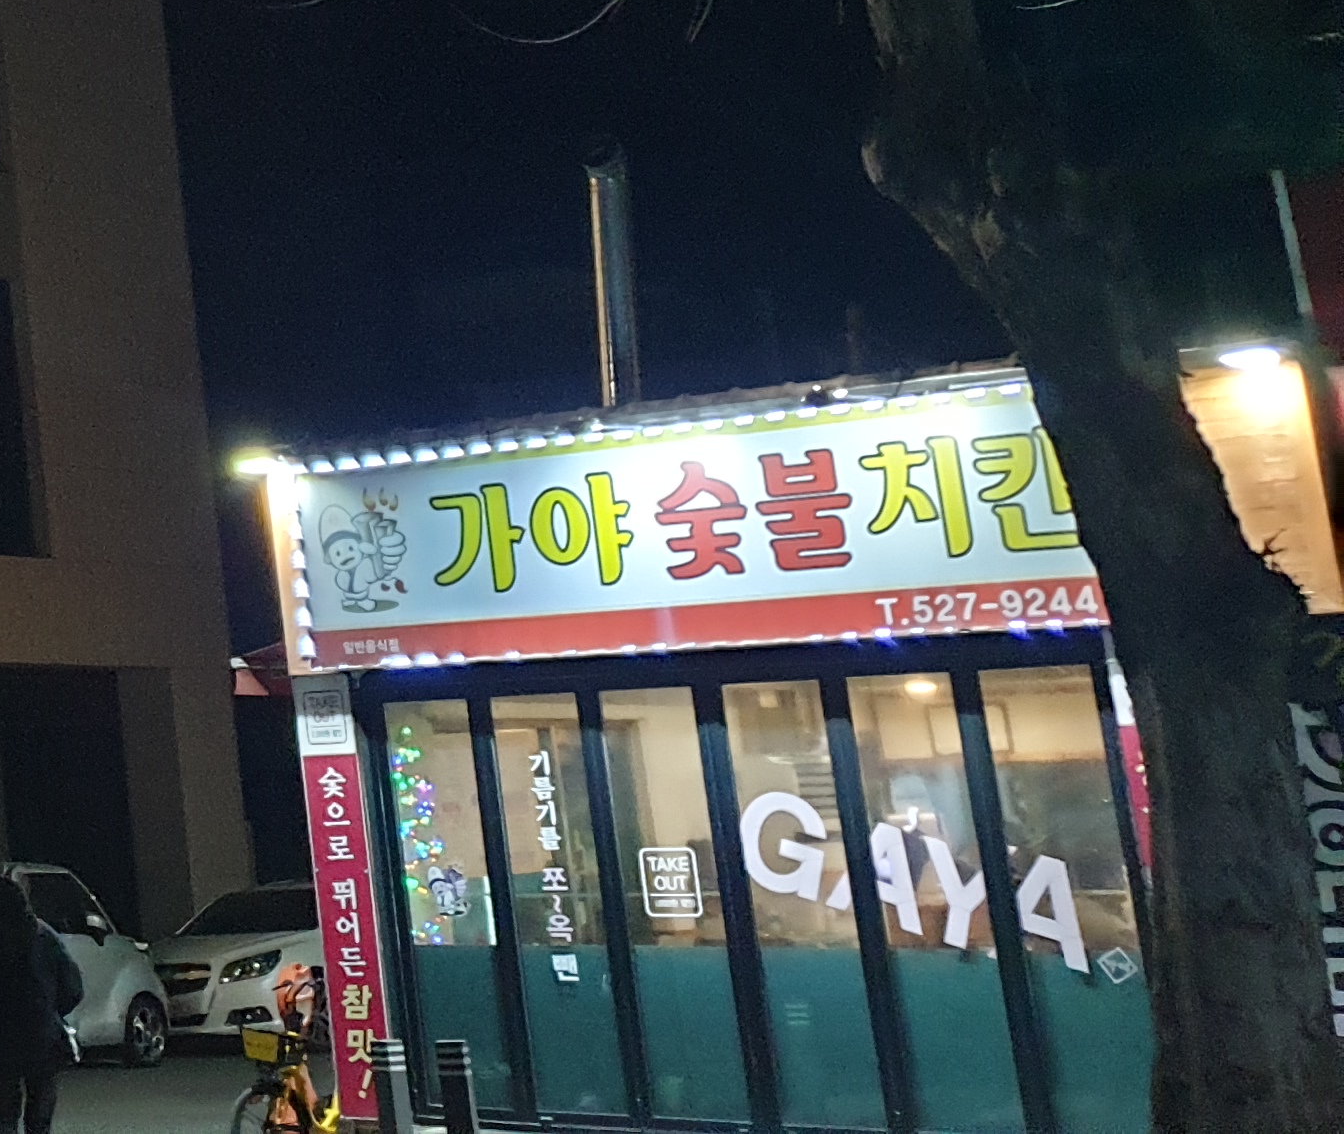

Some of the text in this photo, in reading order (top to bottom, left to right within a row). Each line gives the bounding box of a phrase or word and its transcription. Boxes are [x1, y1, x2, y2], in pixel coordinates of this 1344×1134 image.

[428, 426, 1081, 593] 가야 숯불 치킨
[875, 582, 1099, 628] T.527-9244
[317, 766, 356, 862] 숯으로
[528, 750, 562, 851] 기름기를
[645, 855, 690, 873] TAKE
[653, 875, 689, 892] OUT
[739, 790, 1090, 974] GAYA
